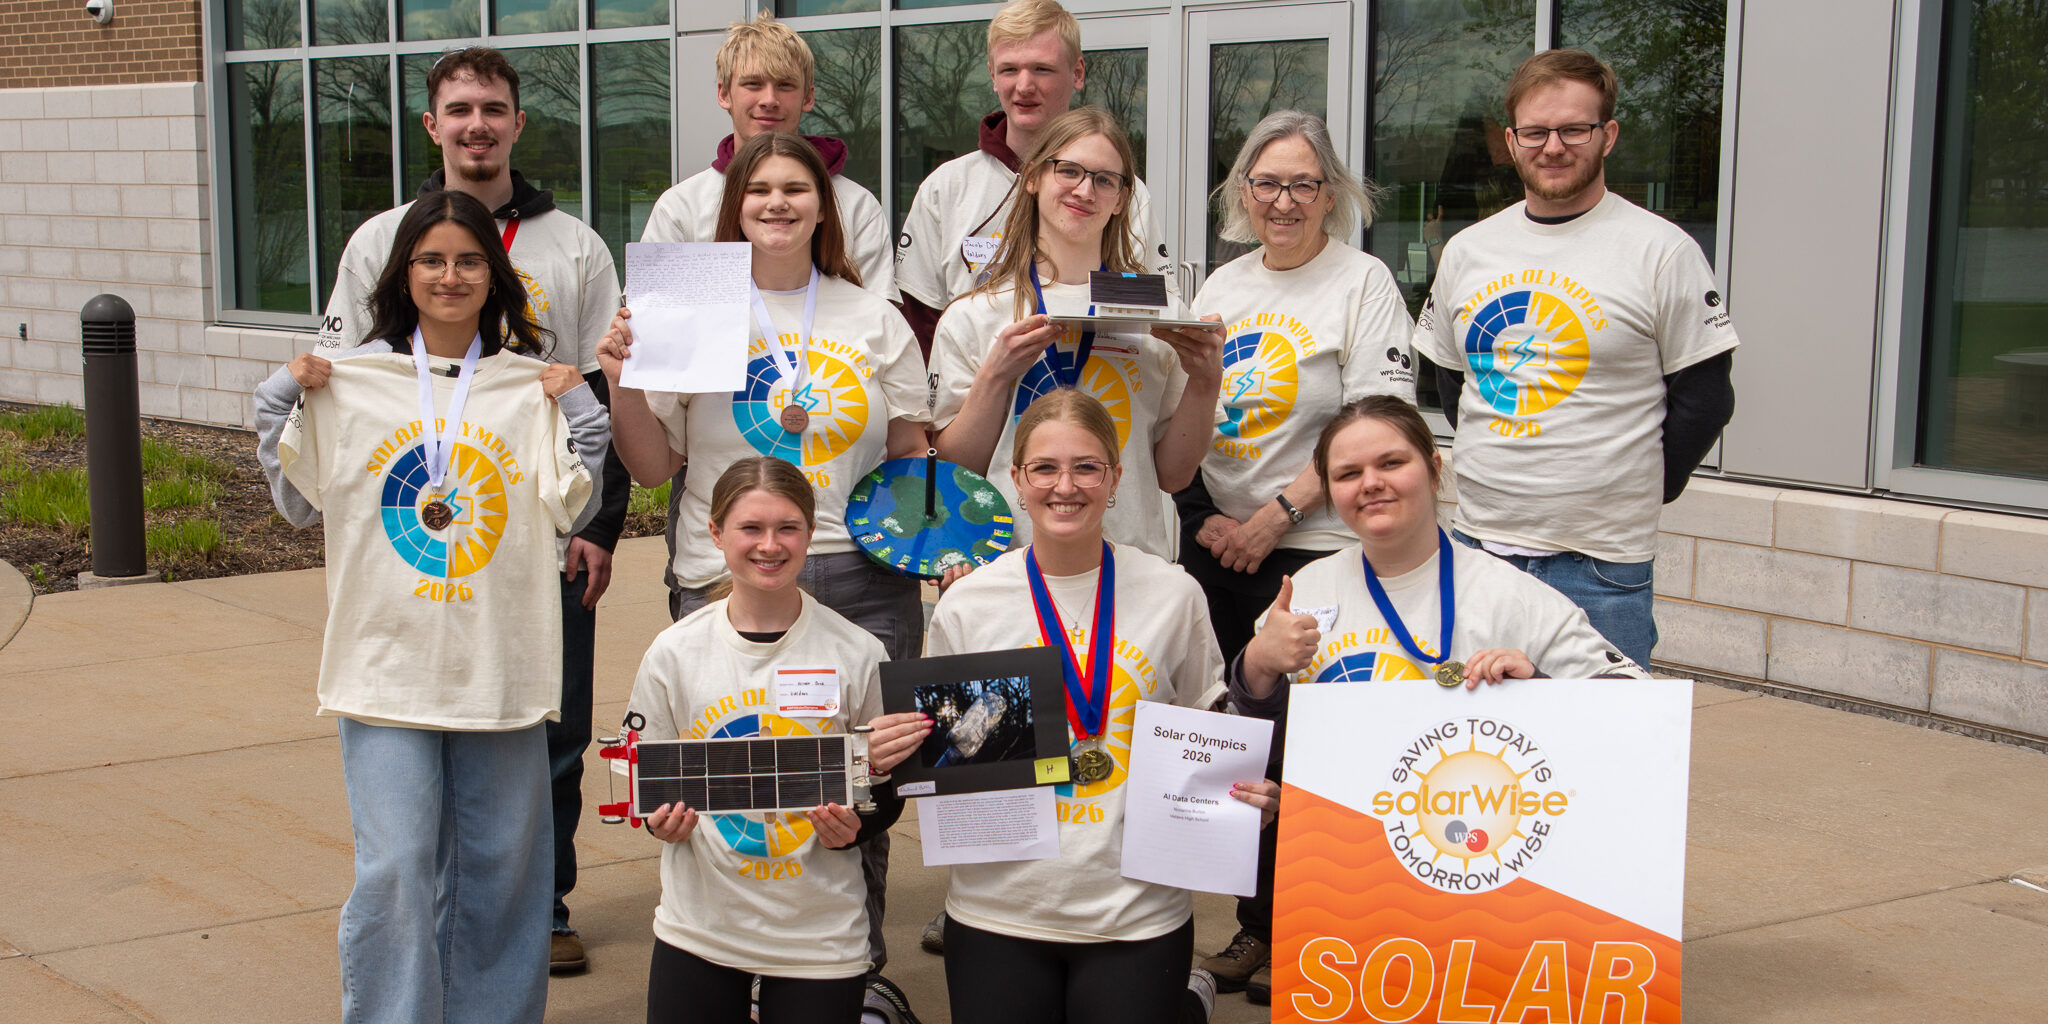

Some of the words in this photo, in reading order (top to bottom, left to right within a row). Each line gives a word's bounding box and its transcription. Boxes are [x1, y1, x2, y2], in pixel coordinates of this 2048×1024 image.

[1521, 269, 1609, 331] OLYMPICS
[1703, 315, 1718, 326] WPS
[1256, 312, 1317, 357] OLYMPICS
[1488, 415, 1542, 438] 2026
[366, 420, 423, 477] SOLAR
[435, 418, 524, 485] OYMPICS
[1214, 436, 1262, 460] 2026
[413, 578, 473, 603] 2026
[691, 695, 738, 739] OLAR
[1153, 726, 1185, 741] Solar
[1188, 732, 1247, 751] Olympics
[1392, 722, 1458, 783] SAVING
[1467, 719, 1538, 757] TODAY
[1531, 759, 1552, 783] IS
[1182, 749, 1212, 764] 2026
[1172, 794, 1189, 803] Data
[1190, 796, 1219, 806] Centers
[1372, 783, 1568, 816] solarWise
[1056, 801, 1105, 824] 026
[1454, 831, 1478, 844] WPS
[1389, 821, 1500, 891] TOMORROW
[1504, 820, 1551, 873] WISE
[738, 857, 803, 880] 2026
[1291, 936, 1656, 1024] SOLAR
